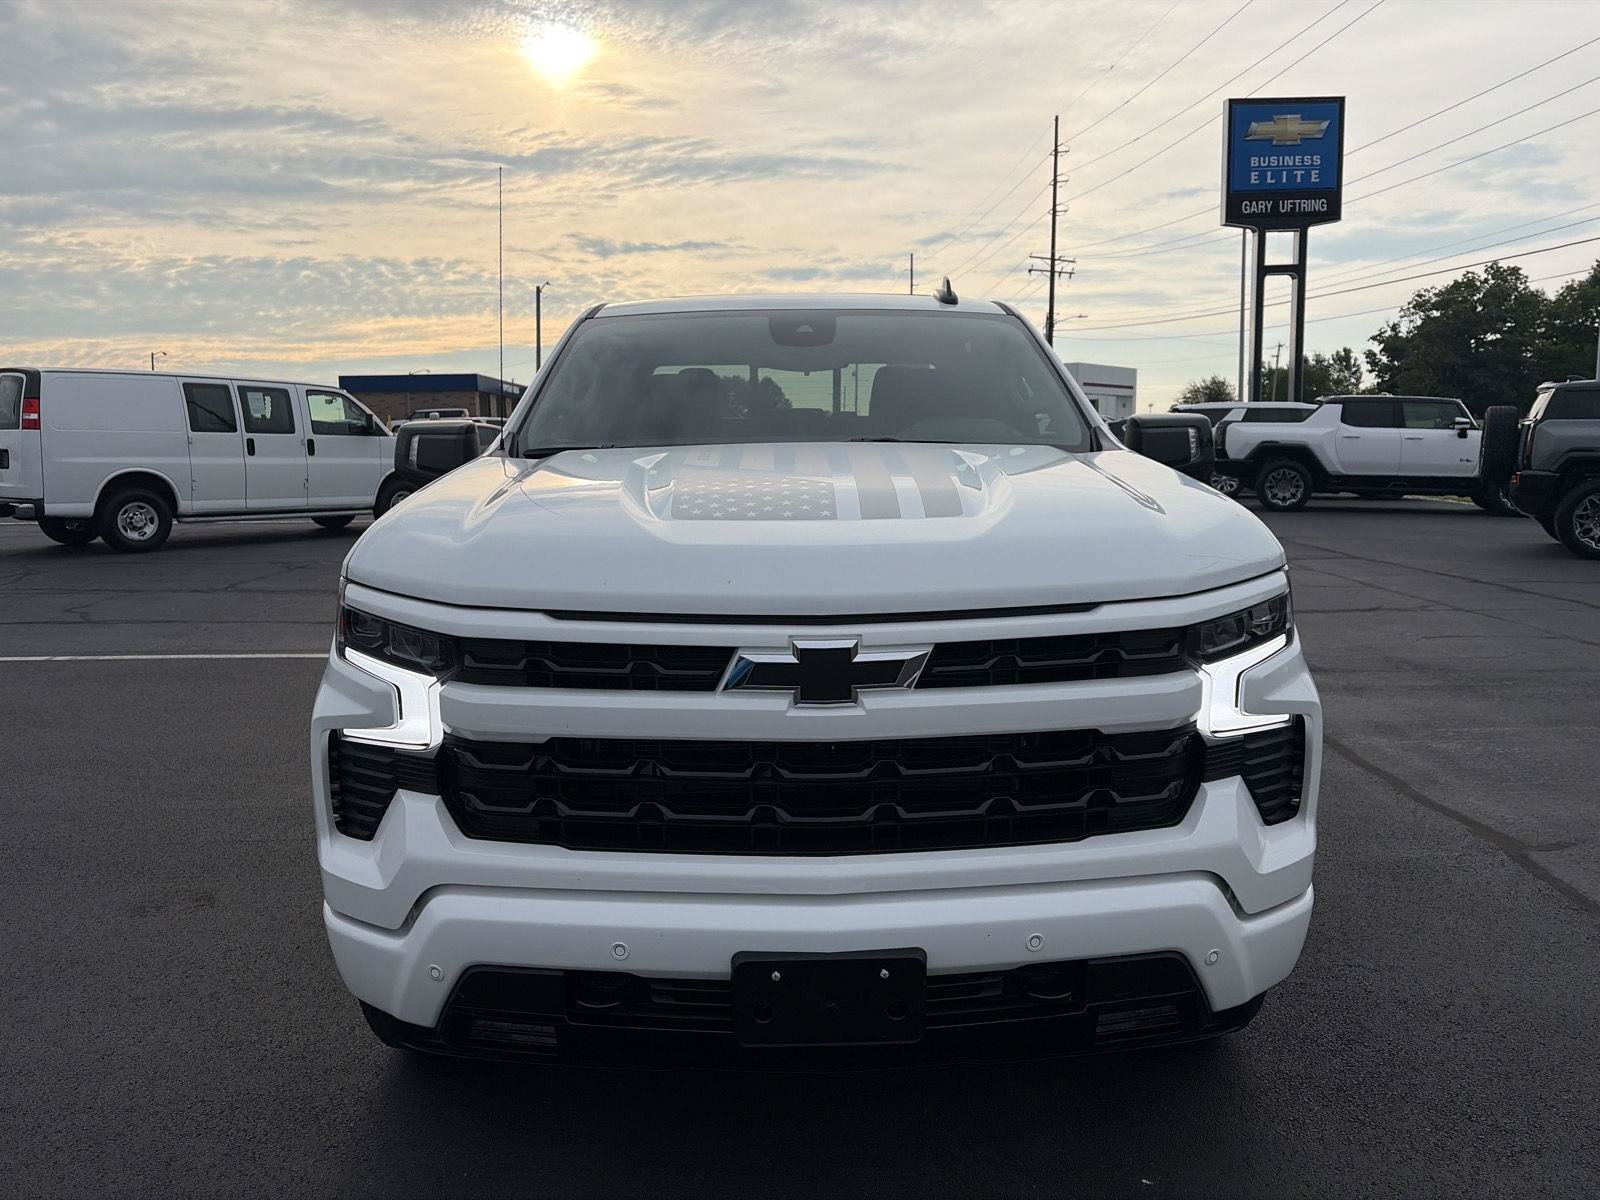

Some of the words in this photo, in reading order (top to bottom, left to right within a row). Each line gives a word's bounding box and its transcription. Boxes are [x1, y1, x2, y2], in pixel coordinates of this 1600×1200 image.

[1250, 155, 1321, 167] BUSINESS
[1250, 170, 1320, 184] ELITE
[1242, 200, 1273, 214] GARY
[1279, 199, 1327, 213] UFTRING
